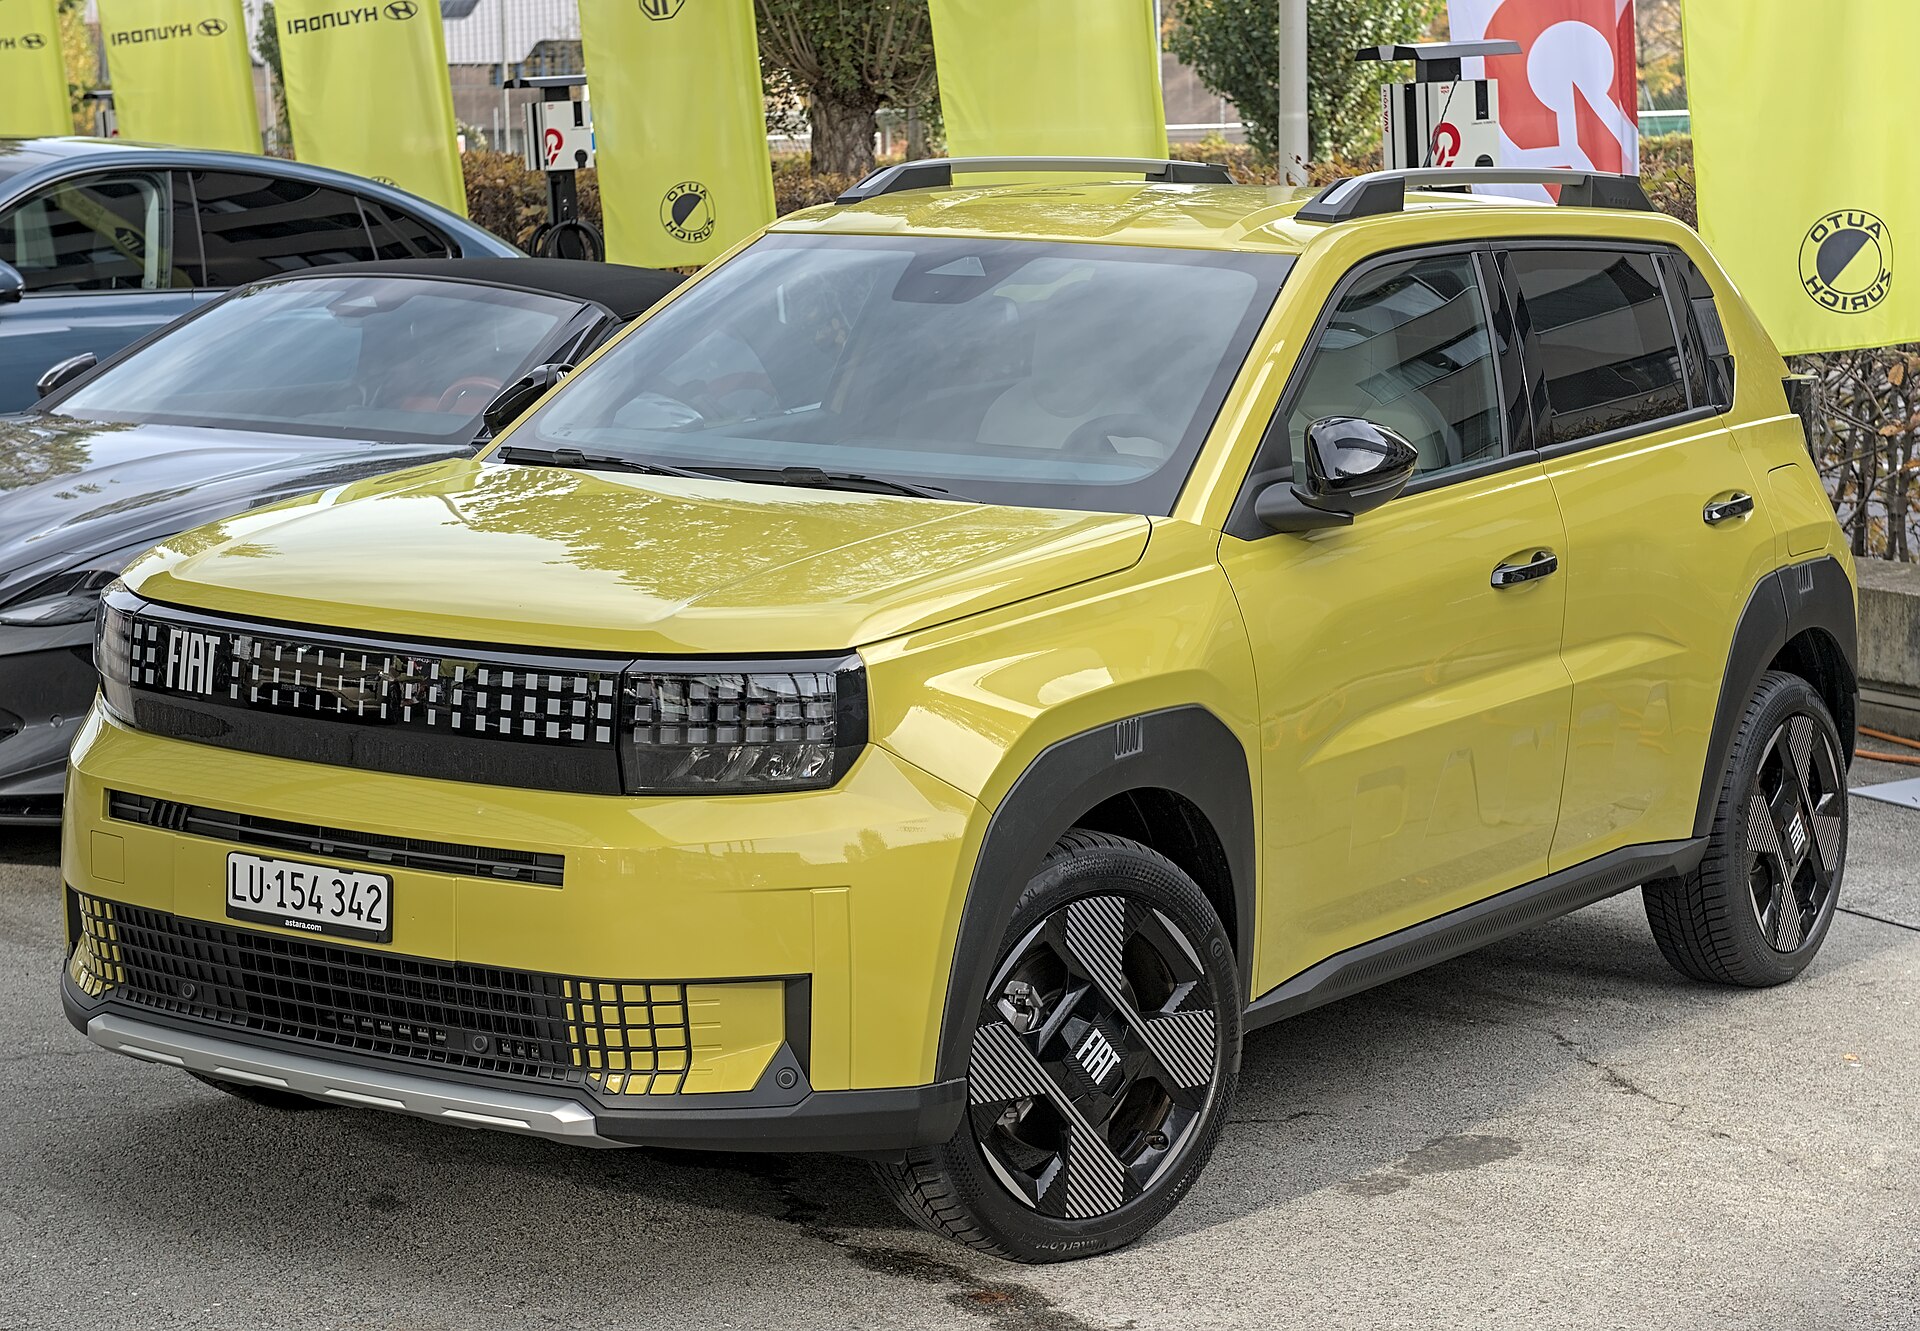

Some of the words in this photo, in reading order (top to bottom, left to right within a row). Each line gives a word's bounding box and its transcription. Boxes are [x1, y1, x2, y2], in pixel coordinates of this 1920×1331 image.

[166, 629, 221, 695] FIAT
[1788, 811, 1806, 855] FIAT
[330, 878, 382, 924] 342
[285, 918, 322, 932] astara.com
[1075, 1027, 1122, 1086] FIAT
